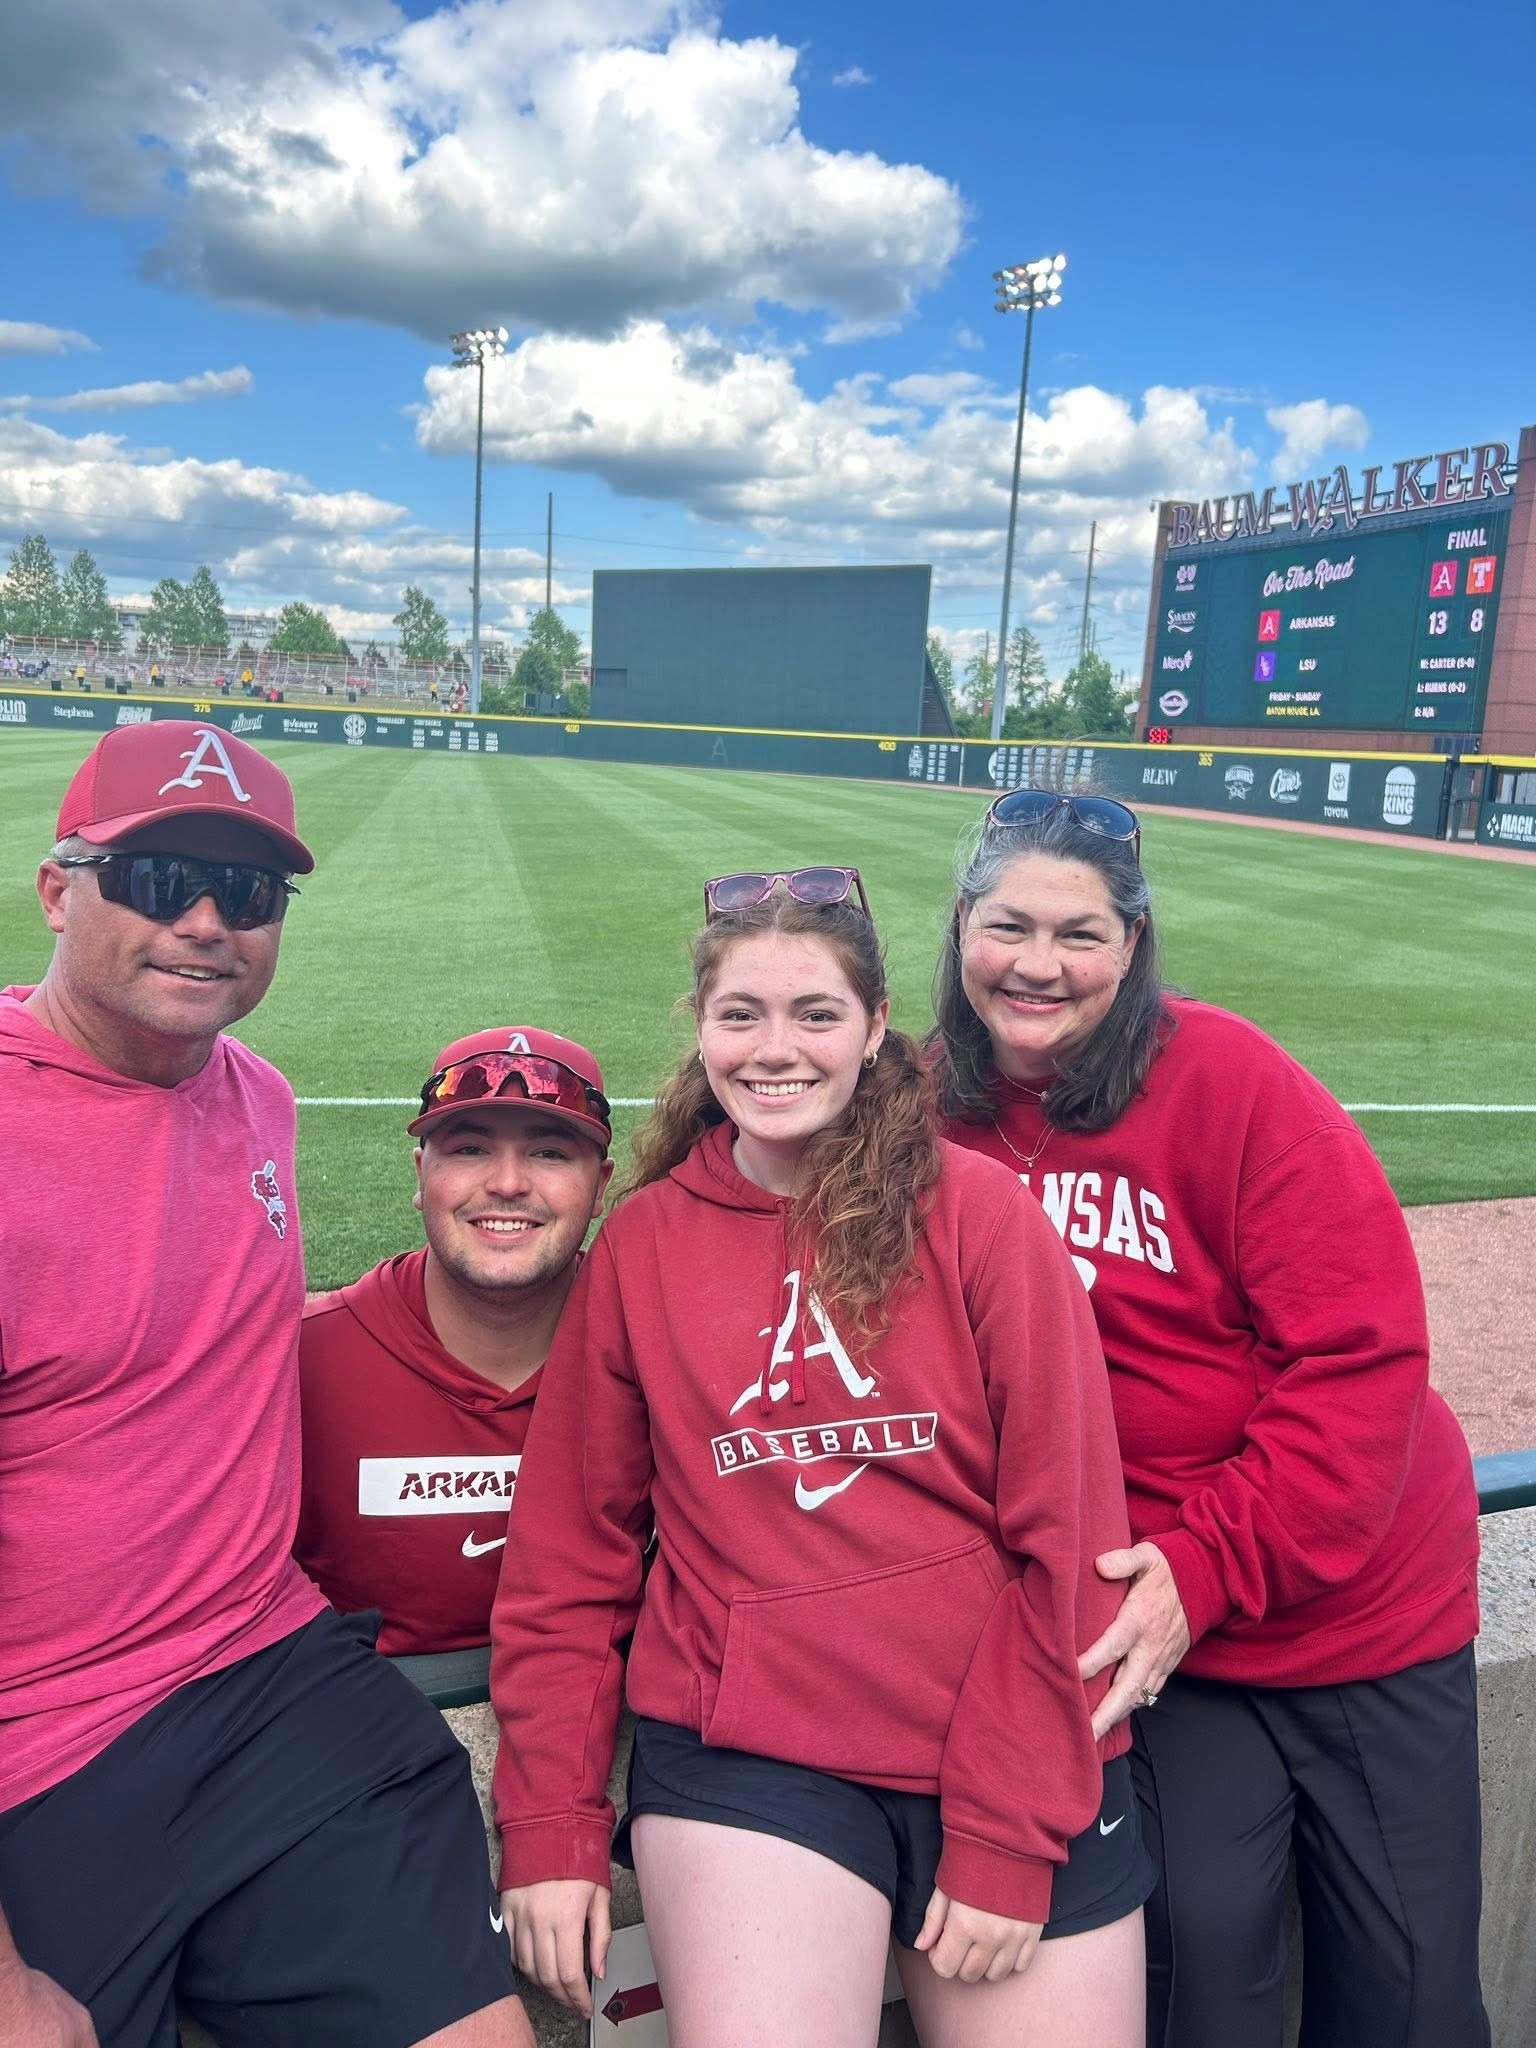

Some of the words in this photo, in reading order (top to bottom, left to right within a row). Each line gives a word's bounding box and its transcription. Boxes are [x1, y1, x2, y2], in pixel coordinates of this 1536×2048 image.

[1168, 442, 1511, 549] BAUM-WALKER
[1447, 528, 1487, 550] FINAL
[1263, 570, 1285, 597] On
[1285, 565, 1314, 591] The
[1315, 555, 1355, 590] Road
[1432, 565, 1452, 592] A
[1472, 562, 1492, 588] T
[1262, 615, 1275, 635] A
[1289, 615, 1336, 630] ARKANSAS
[1429, 610, 1448, 635] 13
[1470, 608, 1484, 632] 8
[1298, 658, 1317, 671] LSU
[1429, 658, 1456, 669] CARTER
[1269, 691, 1292, 702] FRIDAY
[1295, 691, 1322, 702] SUNDAY
[53, 704, 95, 719] Stephens
[193, 703, 211, 713] 375
[344, 718, 366, 738] SEC
[564, 724, 580, 733] 400
[878, 741, 897, 751] 400
[157, 729, 253, 802] A
[1143, 767, 1179, 786] BLEW
[1385, 783, 1415, 799] BURGER
[1323, 805, 1349, 819] TOYOTA
[1383, 796, 1414, 814] KING
[1500, 813, 1533, 835] MACH
[1018, 1171, 1176, 1274] NSAS
[729, 1269, 876, 1417] A
[718, 1420, 932, 1468] BASEBALL
